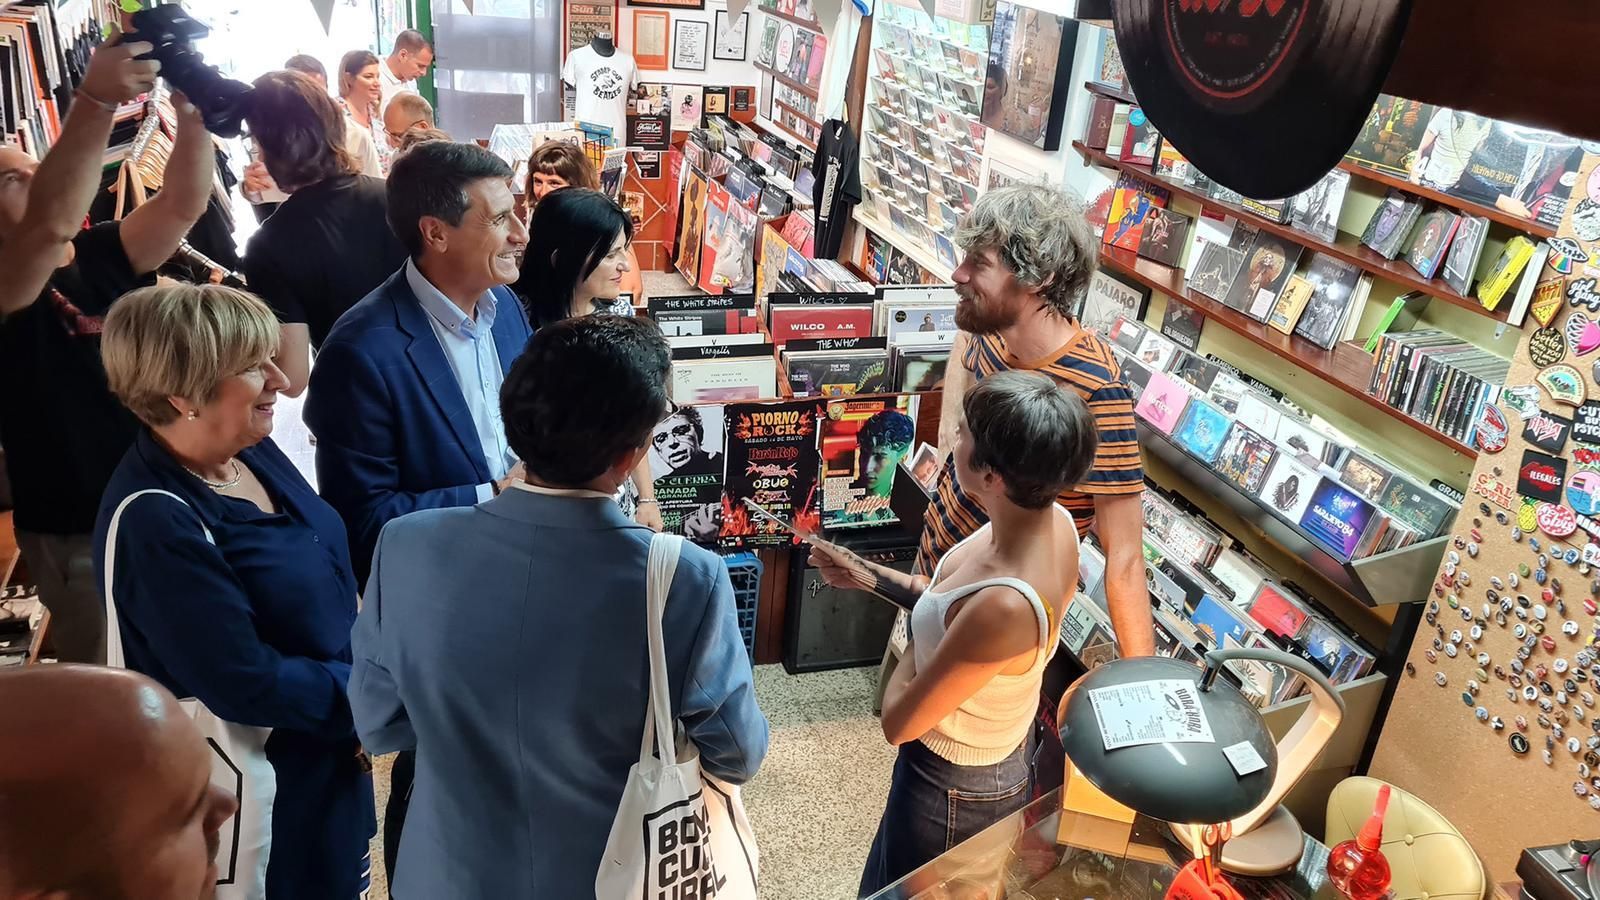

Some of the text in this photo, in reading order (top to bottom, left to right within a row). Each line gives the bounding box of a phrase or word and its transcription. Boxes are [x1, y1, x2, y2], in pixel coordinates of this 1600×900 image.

[816, 339, 832, 350] THE
[1210, 356, 1240, 378] FLAMENCO
[1250, 378, 1273, 396] VARIOS
[752, 411, 799, 426] PIORNO
[1584, 416, 1600, 425] BU
[752, 424, 796, 436] ROCK
[1574, 422, 1600, 438] PSYC
[1530, 470, 1562, 486] ILEGALES
[654, 487, 697, 495] RANADA
[1472, 483, 1510, 508] POWER
